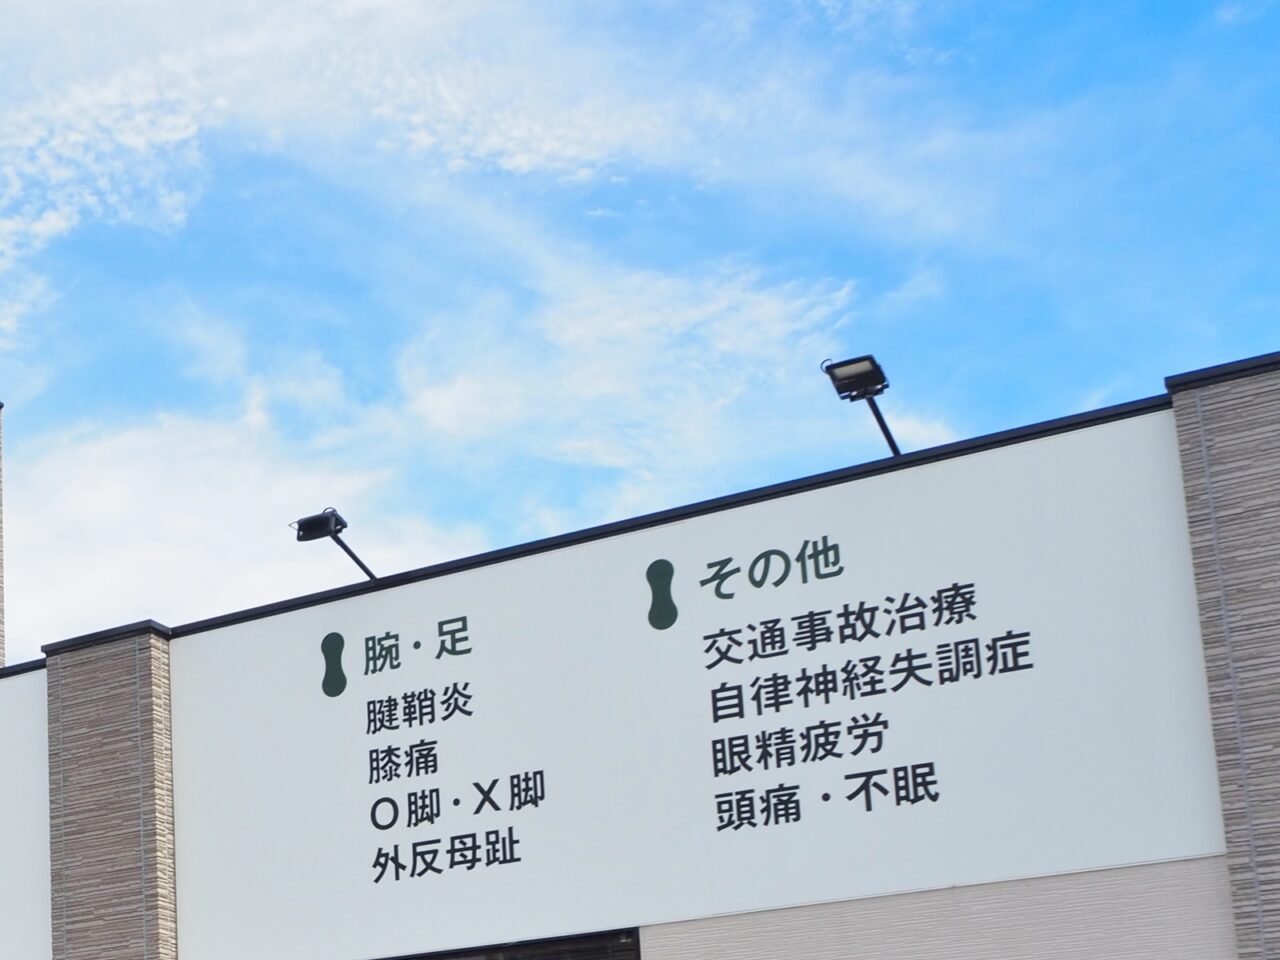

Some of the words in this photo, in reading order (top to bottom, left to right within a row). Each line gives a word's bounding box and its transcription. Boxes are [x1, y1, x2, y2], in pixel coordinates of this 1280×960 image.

[698, 536, 845, 601] その他
[363, 616, 472, 676] 腕・足
[703, 582, 977, 670] 交通事故治療
[365, 682, 473, 735] 腱鞘炎
[710, 631, 1034, 723] 自律神経失調症
[368, 740, 439, 784] 膝痛
[711, 713, 889, 777] 眼精疲労
[715, 762, 940, 832] 頭痛・不眠
[371, 827, 522, 883] 外反母趾
